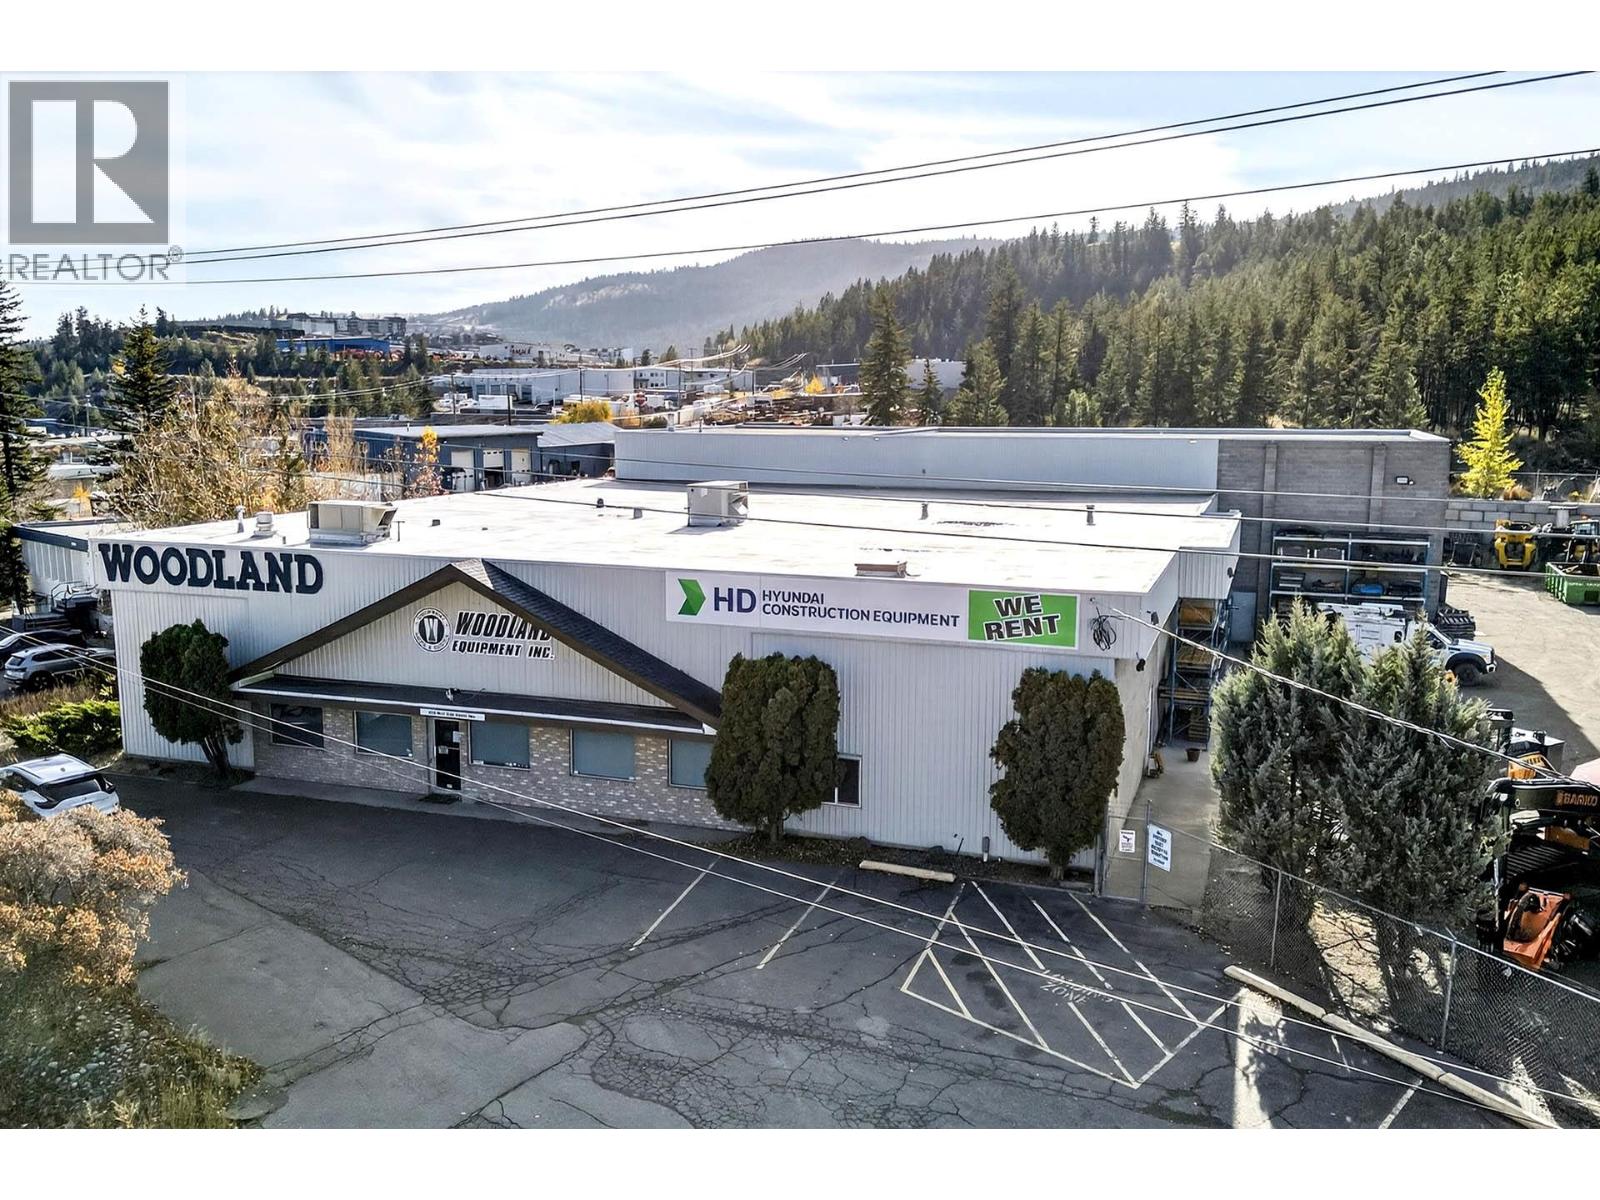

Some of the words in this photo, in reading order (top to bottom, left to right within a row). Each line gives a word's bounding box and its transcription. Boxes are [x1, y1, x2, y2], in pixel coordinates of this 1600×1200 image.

[98, 543, 324, 595] WOODLAND
[714, 587, 757, 613] HD
[762, 589, 825, 605] HYUNDAI
[993, 595, 1042, 617] WE
[762, 603, 870, 622] CONSTRUCTION
[873, 610, 960, 627] EQUIPMENT
[984, 614, 1060, 641] RENT
[452, 640, 522, 656] EQUIPMENT
[528, 645, 555, 659] INC.
